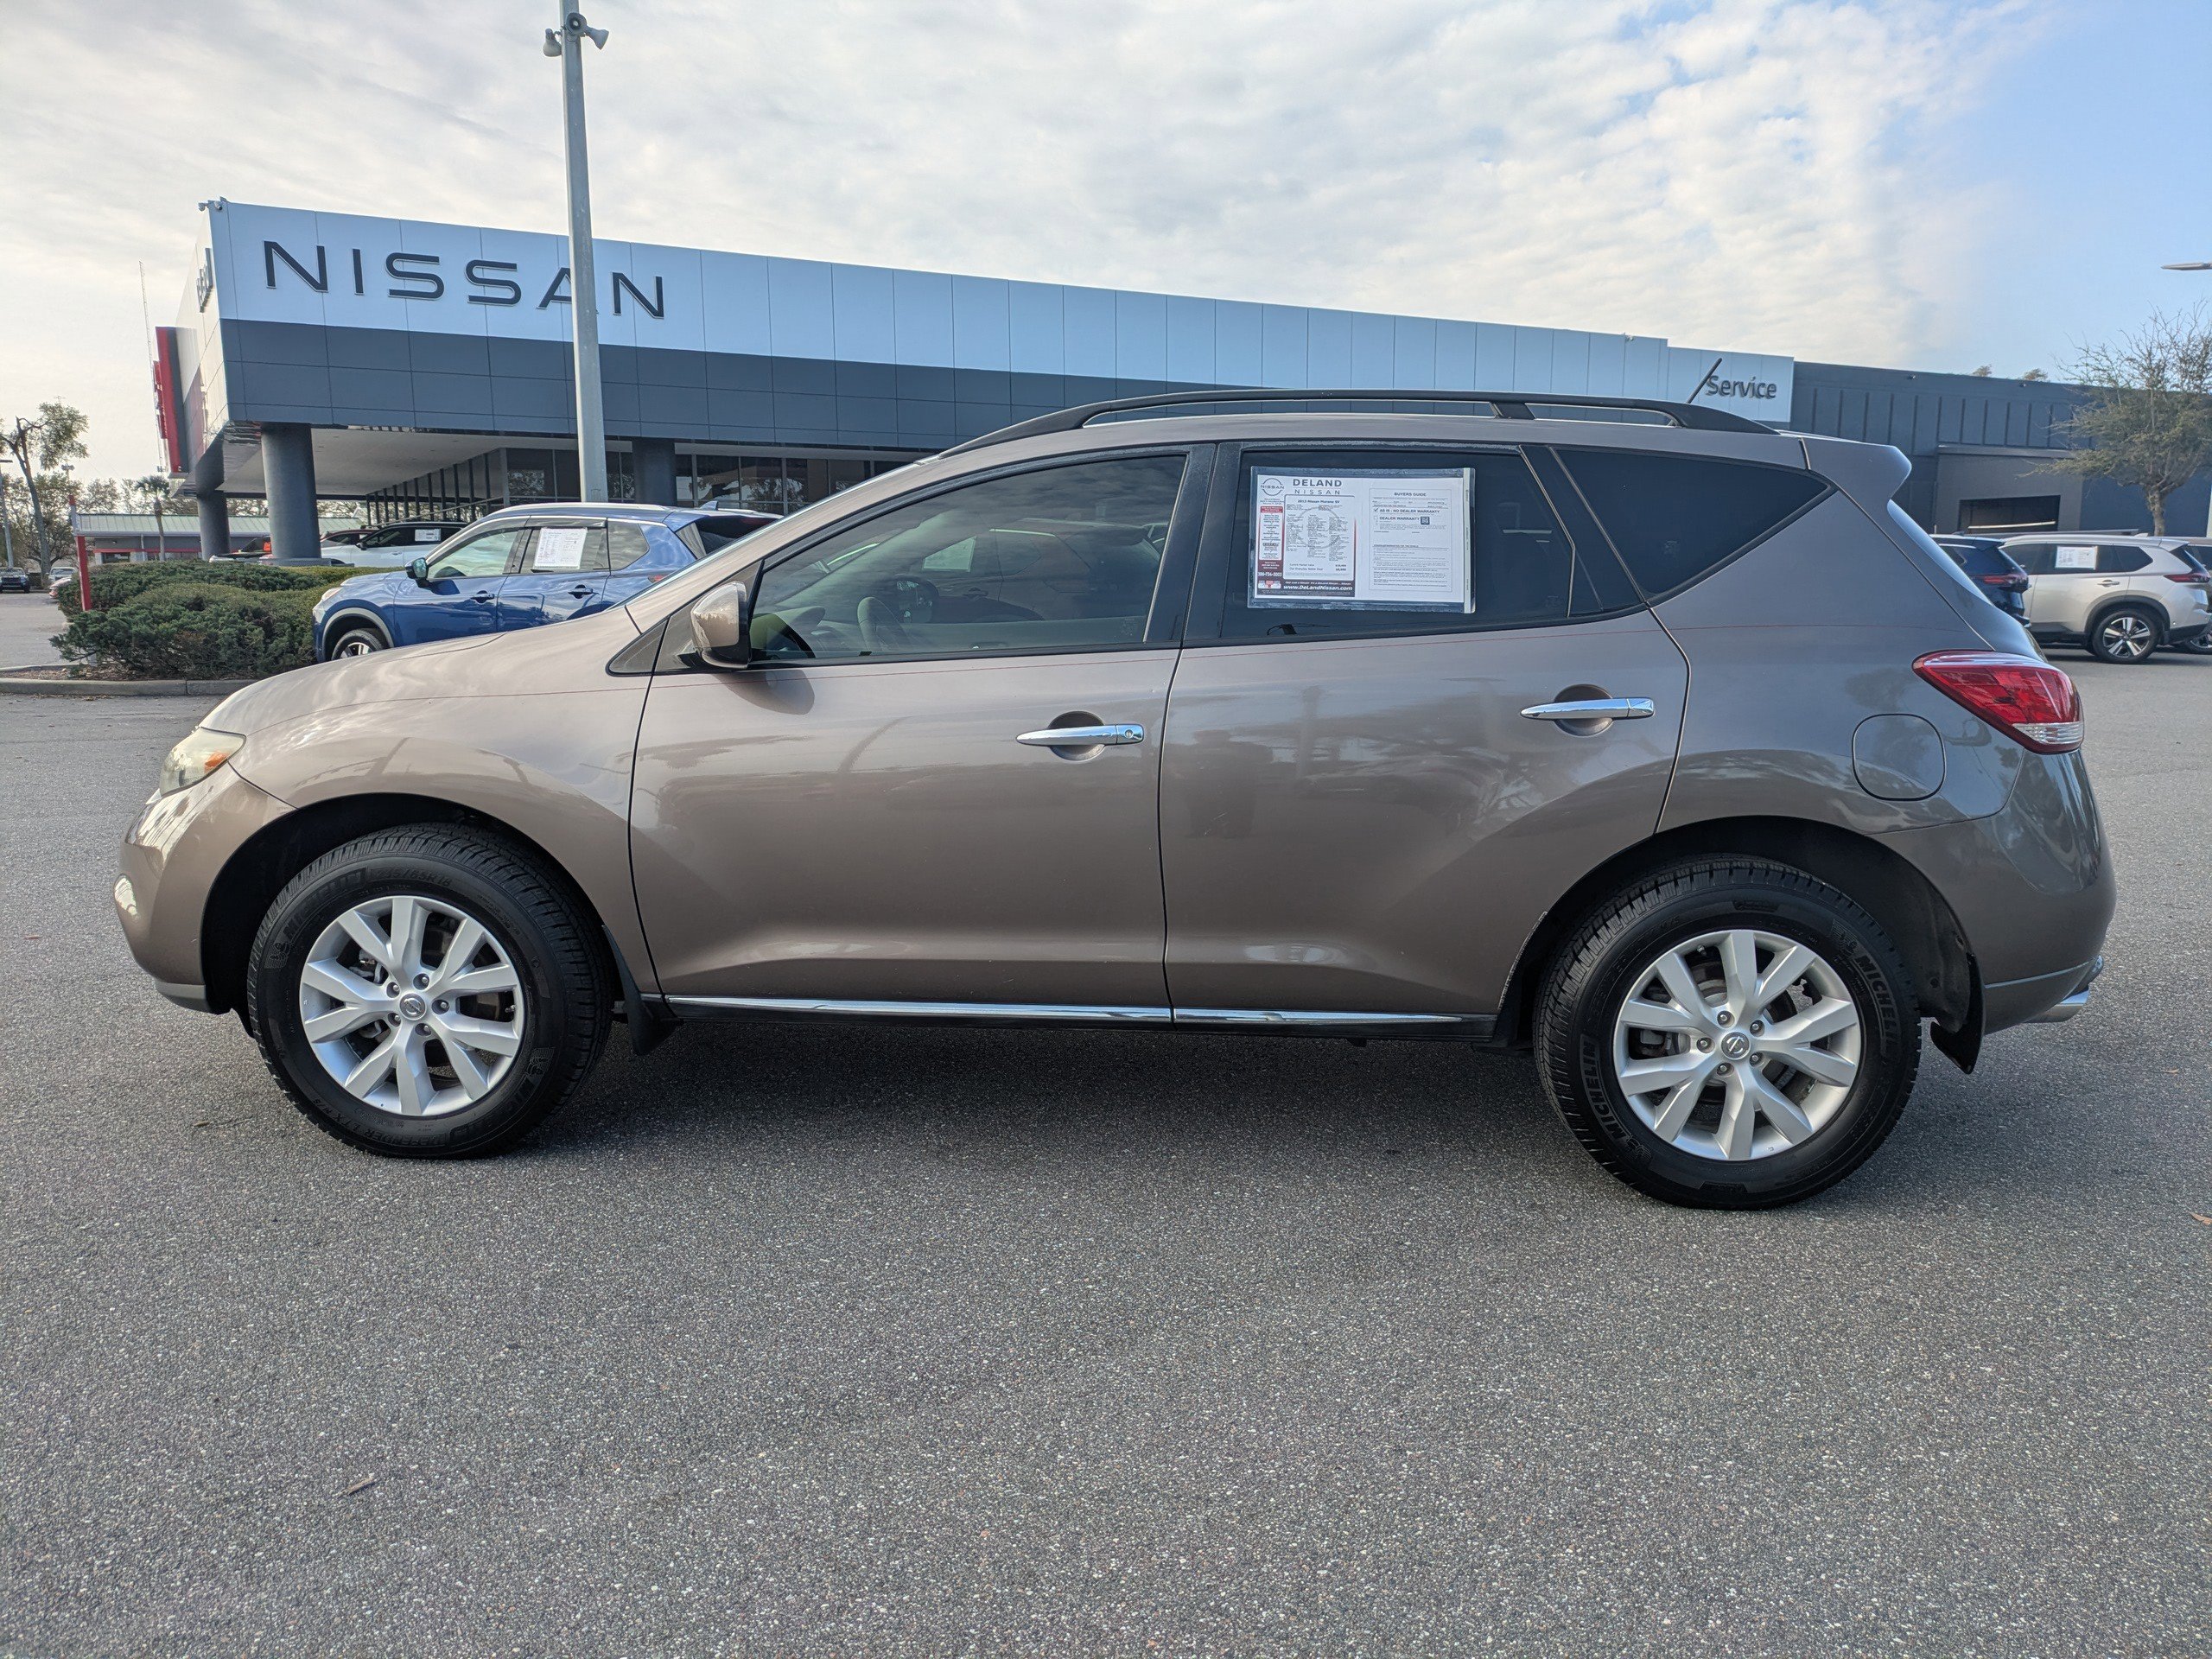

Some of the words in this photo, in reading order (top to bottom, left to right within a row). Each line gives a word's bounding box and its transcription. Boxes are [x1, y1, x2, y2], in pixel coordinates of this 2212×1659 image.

[263, 239, 665, 319] NISSAN
[1706, 375, 1777, 398] Service
[1293, 478, 1343, 487] DELAND
[1582, 1039, 1628, 1140] MICHELIN
